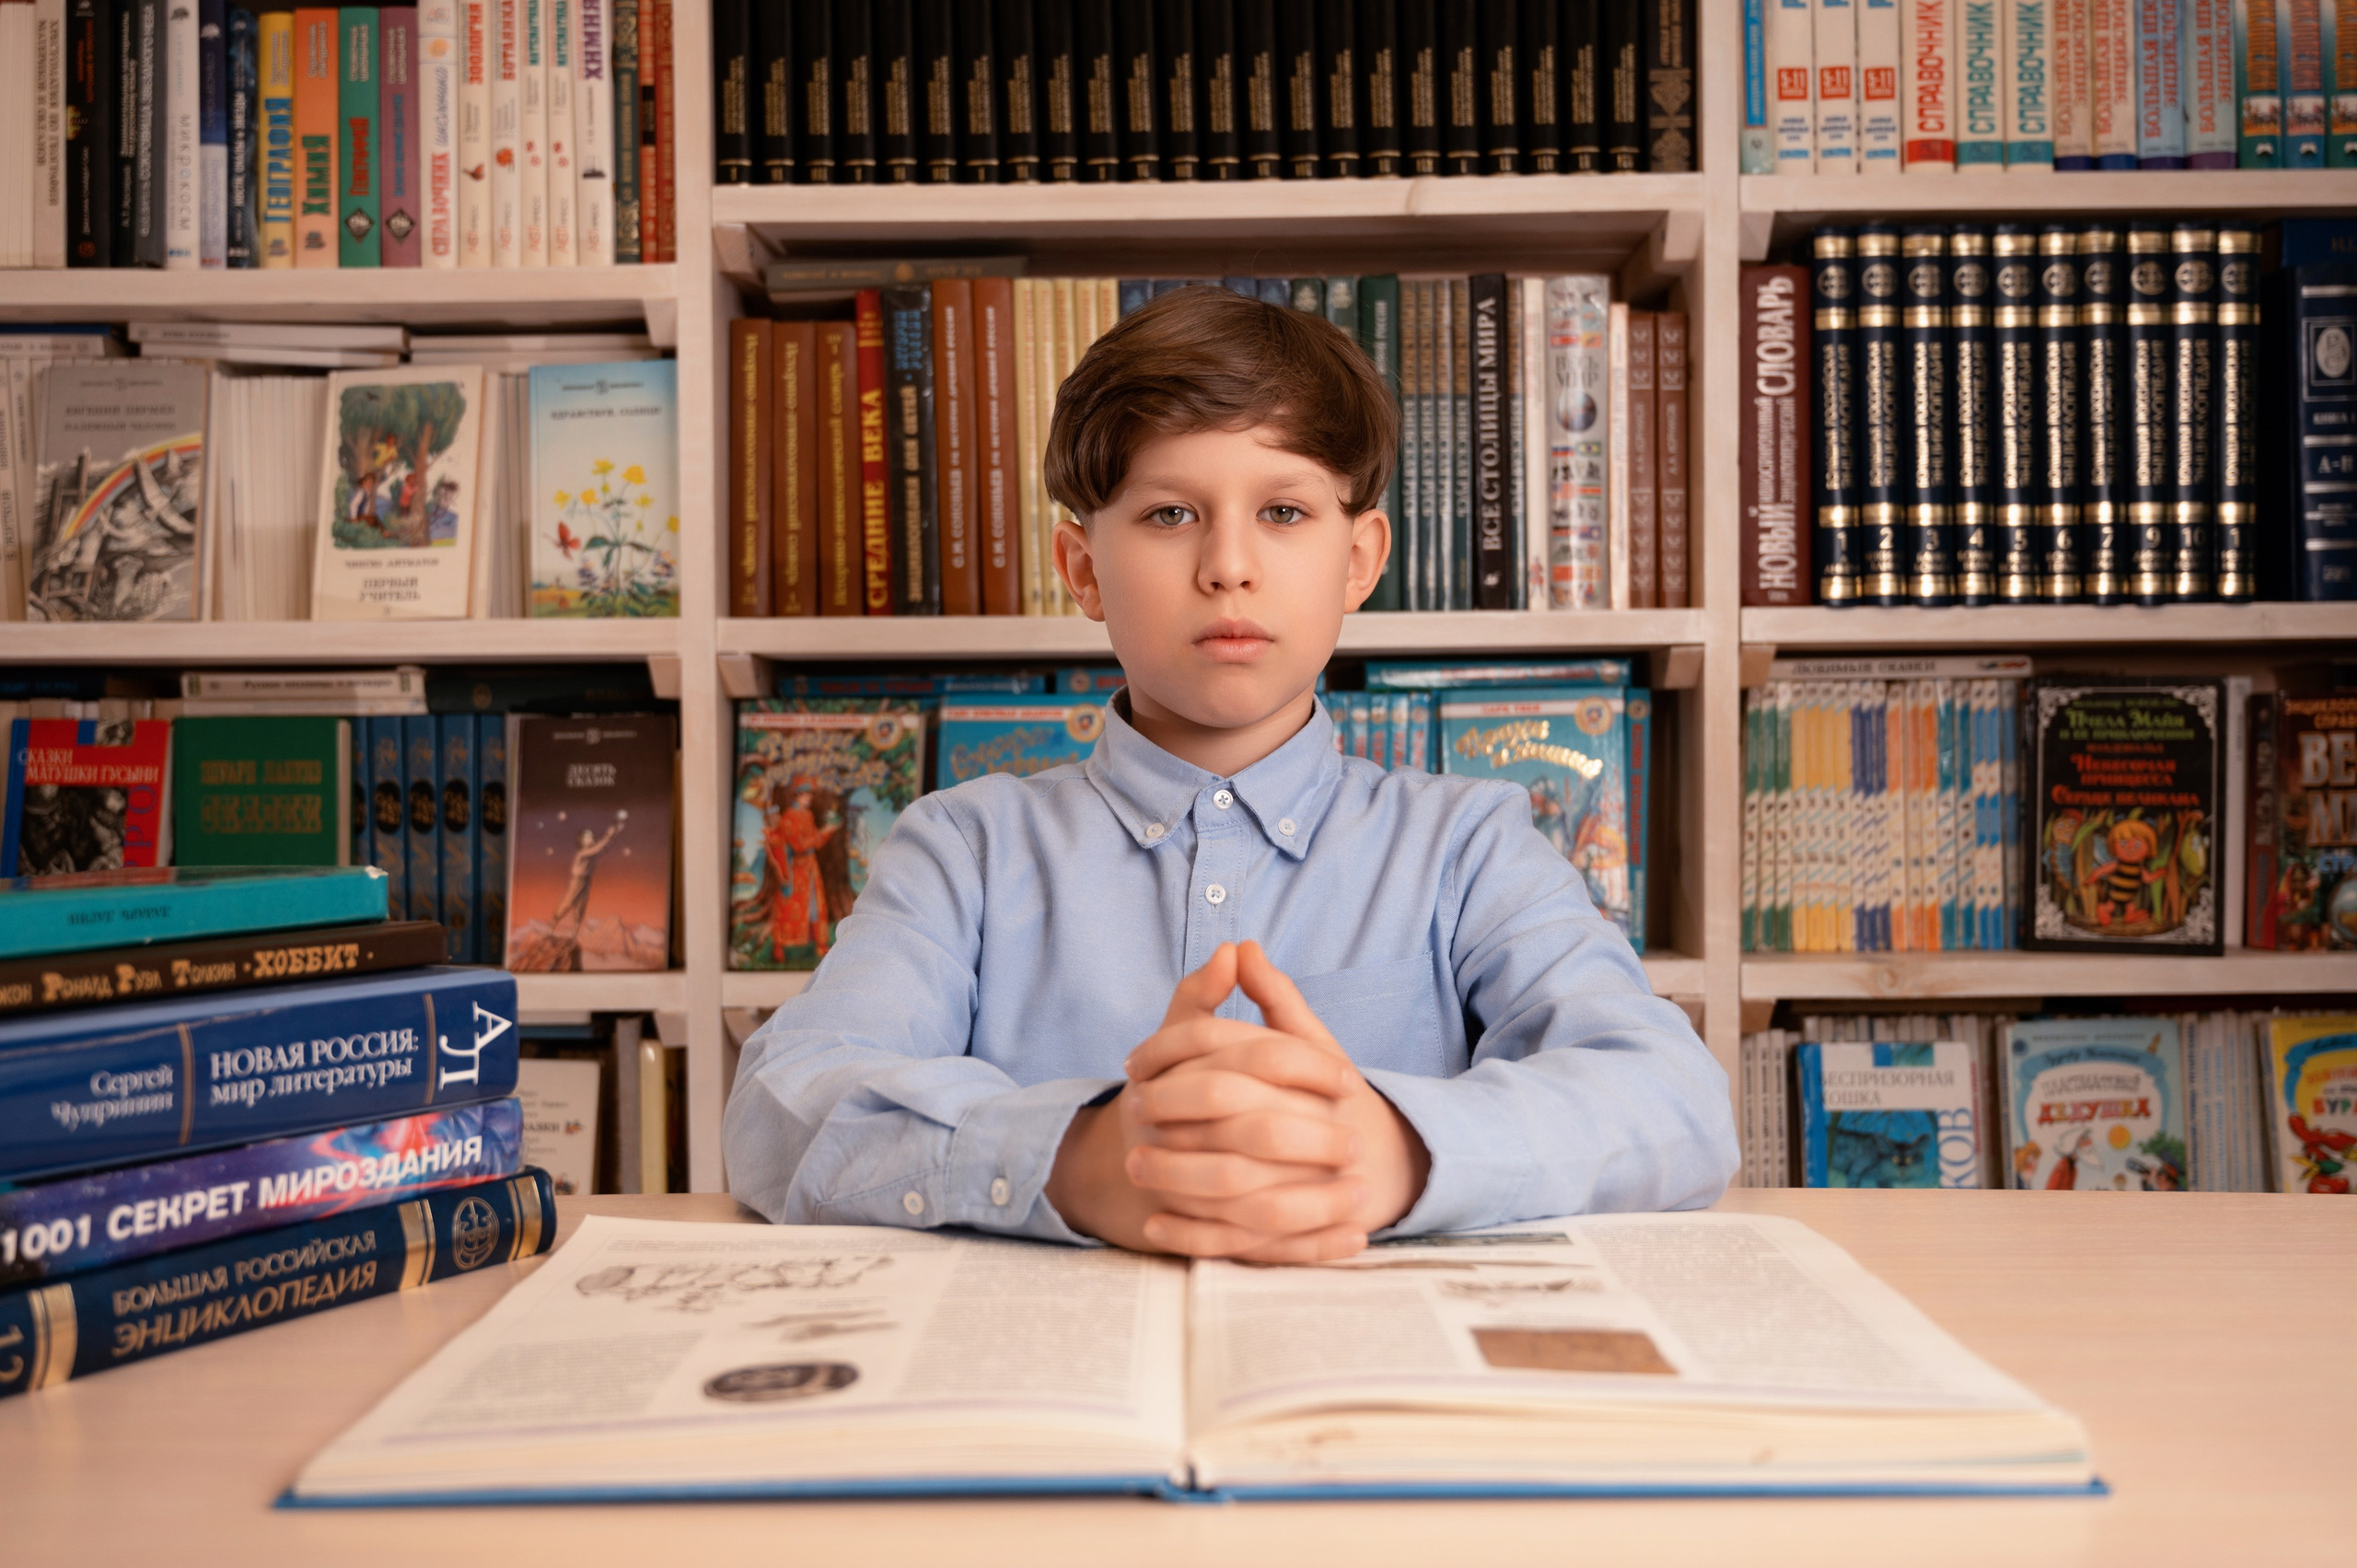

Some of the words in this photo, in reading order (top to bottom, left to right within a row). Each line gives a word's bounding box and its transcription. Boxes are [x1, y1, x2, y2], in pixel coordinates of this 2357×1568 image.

[468, 3, 483, 85] ЗООЛОГИЯ
[502, 0, 516, 81] БОТАНИКА
[583, 0, 603, 80] ХИМИЯ
[1917, 1, 1945, 133] СПРАВОЧНИК
[1967, 1, 1996, 134] СПРАВОЧНИК
[2016, 1, 2046, 134] СПРАВОЧНИК
[2055, 38, 2072, 135] БОЛЬШАЯ
[2096, 38, 2111, 135] БОЛЬШАЯ
[2142, 40, 2160, 137] БОЛЬШАЯ
[2197, 36, 2214, 133] БОЛЬШАЯ
[262, 97, 292, 223] ГЕОГРАФИЯ
[301, 134, 331, 215] ХИМИЯ
[349, 117, 369, 196] ГЕОГРАФИЯ
[431, 152, 450, 256] СПРАВОЧНИК
[1477, 297, 1499, 368] МИРА
[1757, 276, 1796, 396] СЛОВАРЬ
[861, 389, 884, 462] ВЕКА
[1479, 373, 1504, 500] СТОЛИЦЫ
[865, 481, 889, 609] СРЕДНИЕ
[1481, 503, 1504, 552] ВСЕ
[1748, 504, 1796, 589] НОВЫЙ
[1837, 530, 1847, 552] 1
[1879, 527, 1893, 549] 2
[1925, 528, 1939, 550] 3
[1969, 527, 1983, 548] 4
[2014, 528, 2028, 550] 5
[2056, 528, 2073, 550] 6
[2102, 526, 2114, 549] 7
[2145, 527, 2161, 549] 9
[359, 590, 421, 603] УЧИТЕЛЬ
[364, 576, 419, 589] ПЕРВЫЙ
[17, 747, 74, 766] СКАЗКИ
[26, 765, 98, 783] МАТУШКИ
[101, 764, 158, 784] ГУСЫНИ
[567, 775, 615, 787] СКАЗОК
[569, 763, 616, 775] ДЕСЯТЬ
[253, 943, 360, 979] ХОББИТ
[89, 1064, 174, 1098] Сергей
[211, 1041, 306, 1081] НОВАЯ
[310, 1028, 419, 1066] РОССИЯ:
[211, 1078, 266, 1109] мир
[269, 1058, 412, 1097] литературы
[522, 1122, 560, 1132] КАЗКИ
[2037, 1097, 2152, 1125] ДЕДУШКА
[2, 1214, 92, 1265] 1001
[107, 1181, 250, 1241] СЕКРЕТ
[258, 1135, 483, 1210] МИРОЗДАНИЯ
[111, 1260, 377, 1357] ЭНЦИКЛОПЕДИЯ
[112, 1264, 228, 1317] БОЛЬШАЯ
[234, 1230, 377, 1284] РОССИЙСКАЯ
